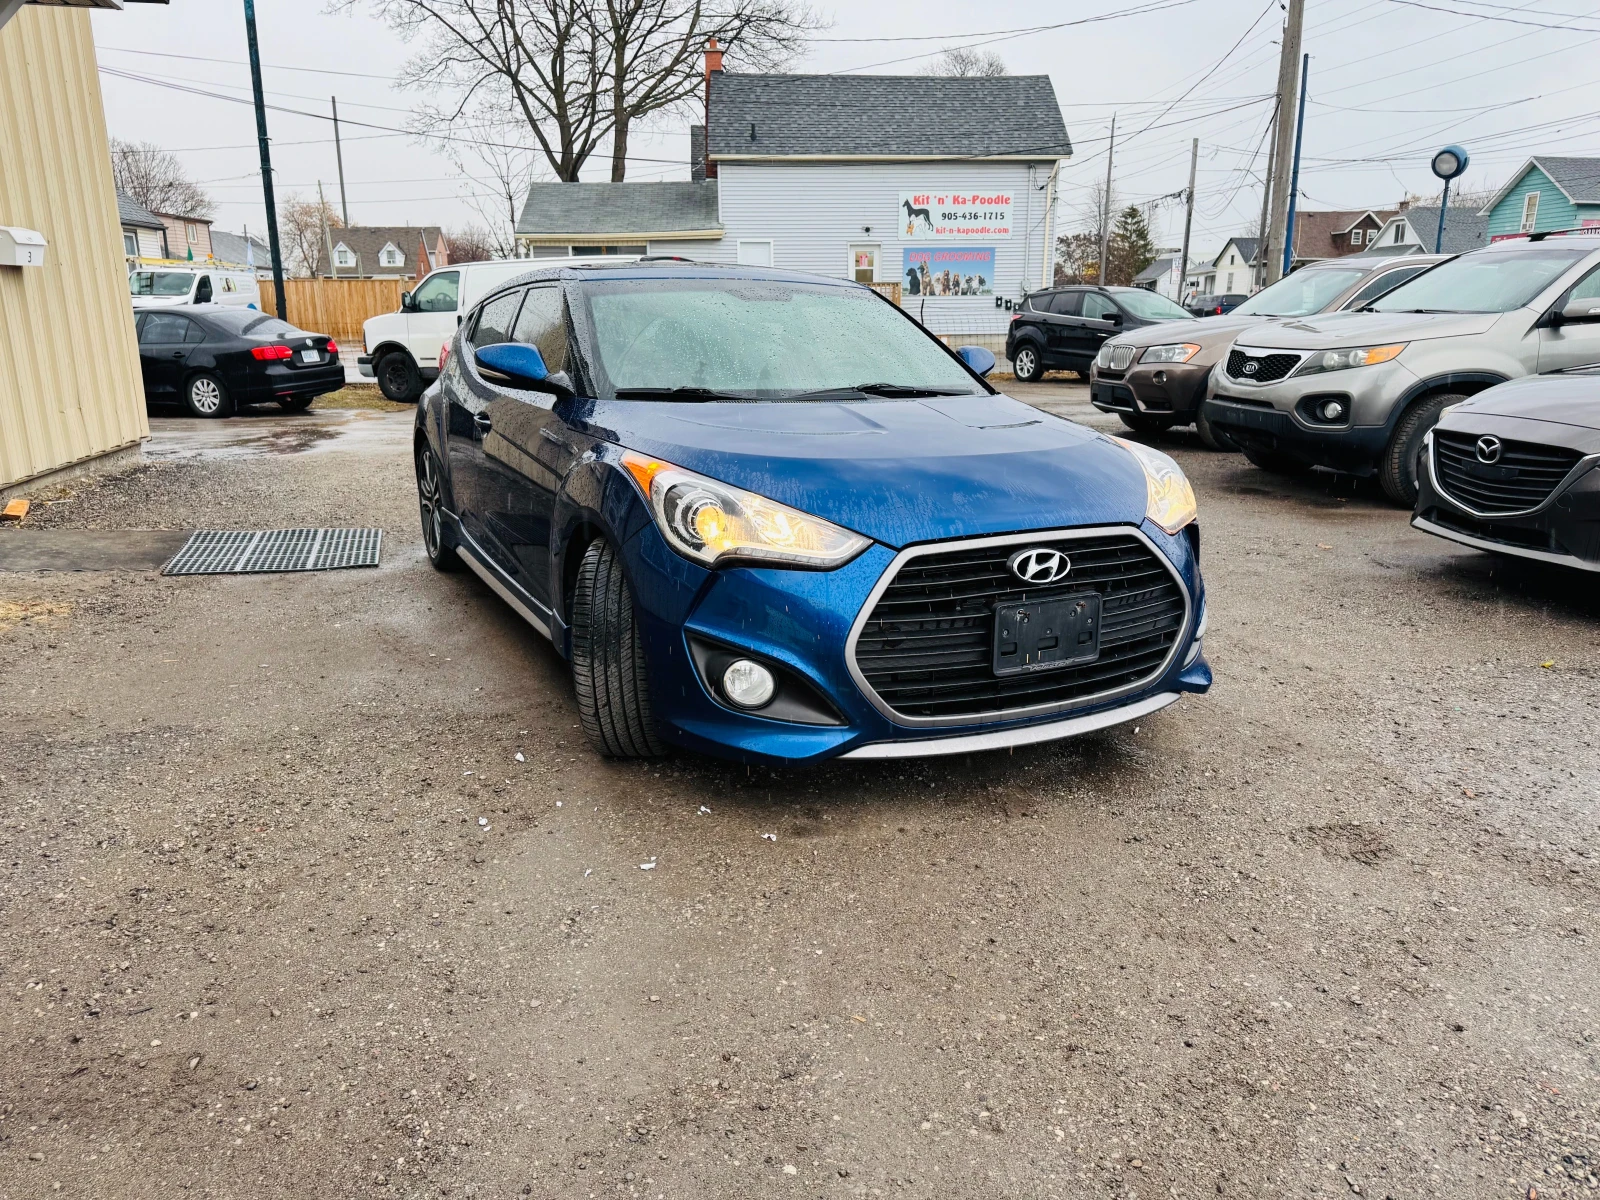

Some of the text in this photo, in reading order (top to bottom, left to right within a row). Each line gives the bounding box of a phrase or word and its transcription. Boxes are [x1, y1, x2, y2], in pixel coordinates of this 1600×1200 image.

[913, 195, 930, 205] Kit
[952, 195, 1011, 205] Ka-Poodle
[941, 212, 1005, 221] 905-436-1715
[935, 227, 1009, 235] kit-n-kapoodle.com
[28, 251, 31, 263] 3
[909, 252, 991, 262] DOG GROOMING
